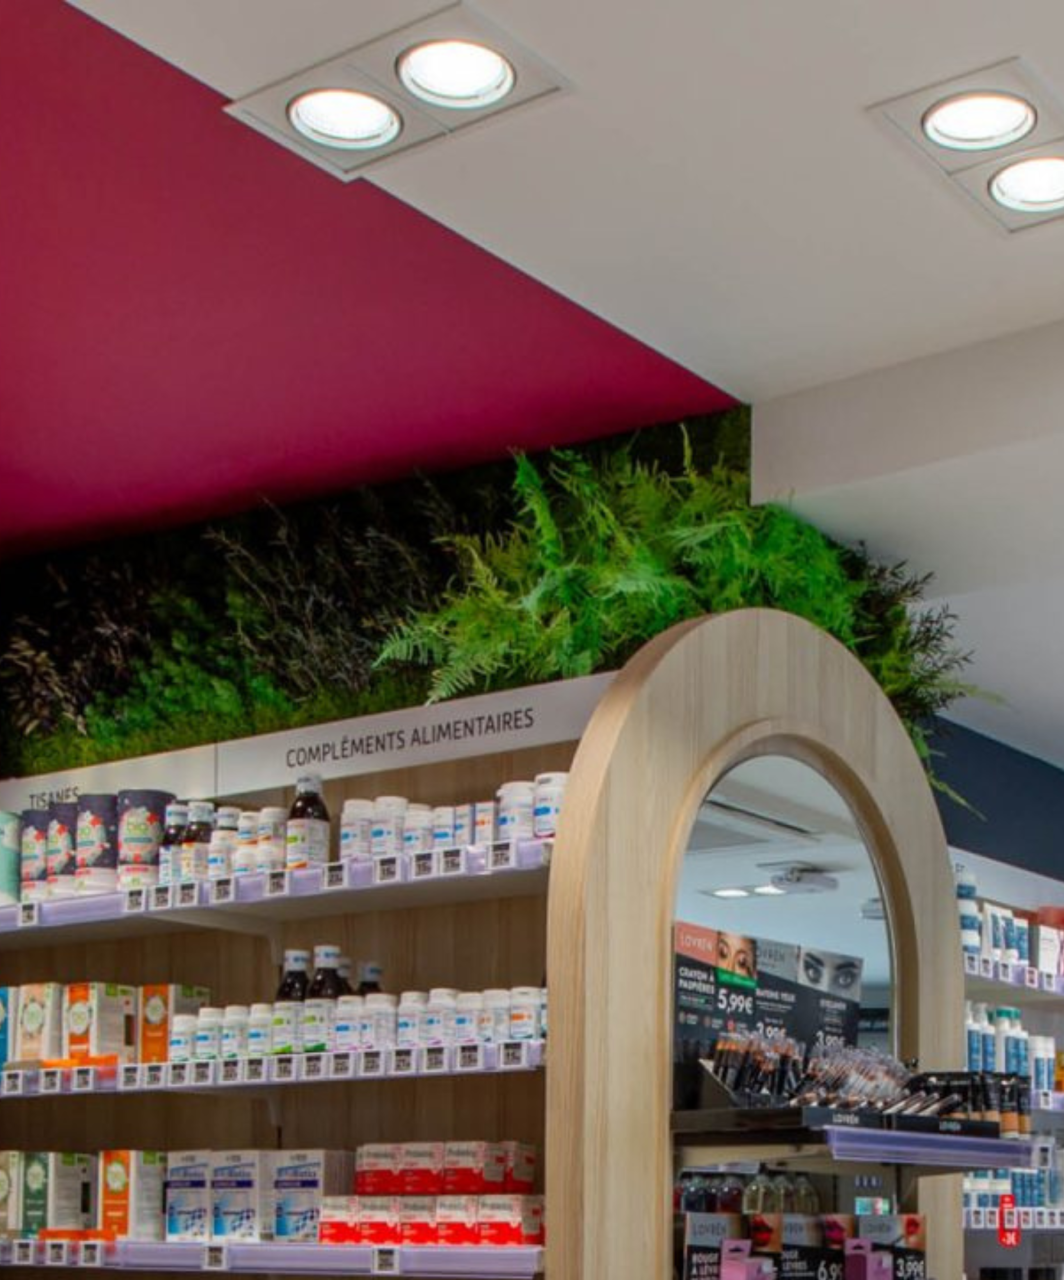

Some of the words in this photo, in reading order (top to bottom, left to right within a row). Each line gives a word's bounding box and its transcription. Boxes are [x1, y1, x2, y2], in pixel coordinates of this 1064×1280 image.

[286, 730, 406, 768] COMPLÉMENTS
[410, 707, 535, 747] ALIMENTAIRES
[717, 987, 754, 1015] 5,99€
